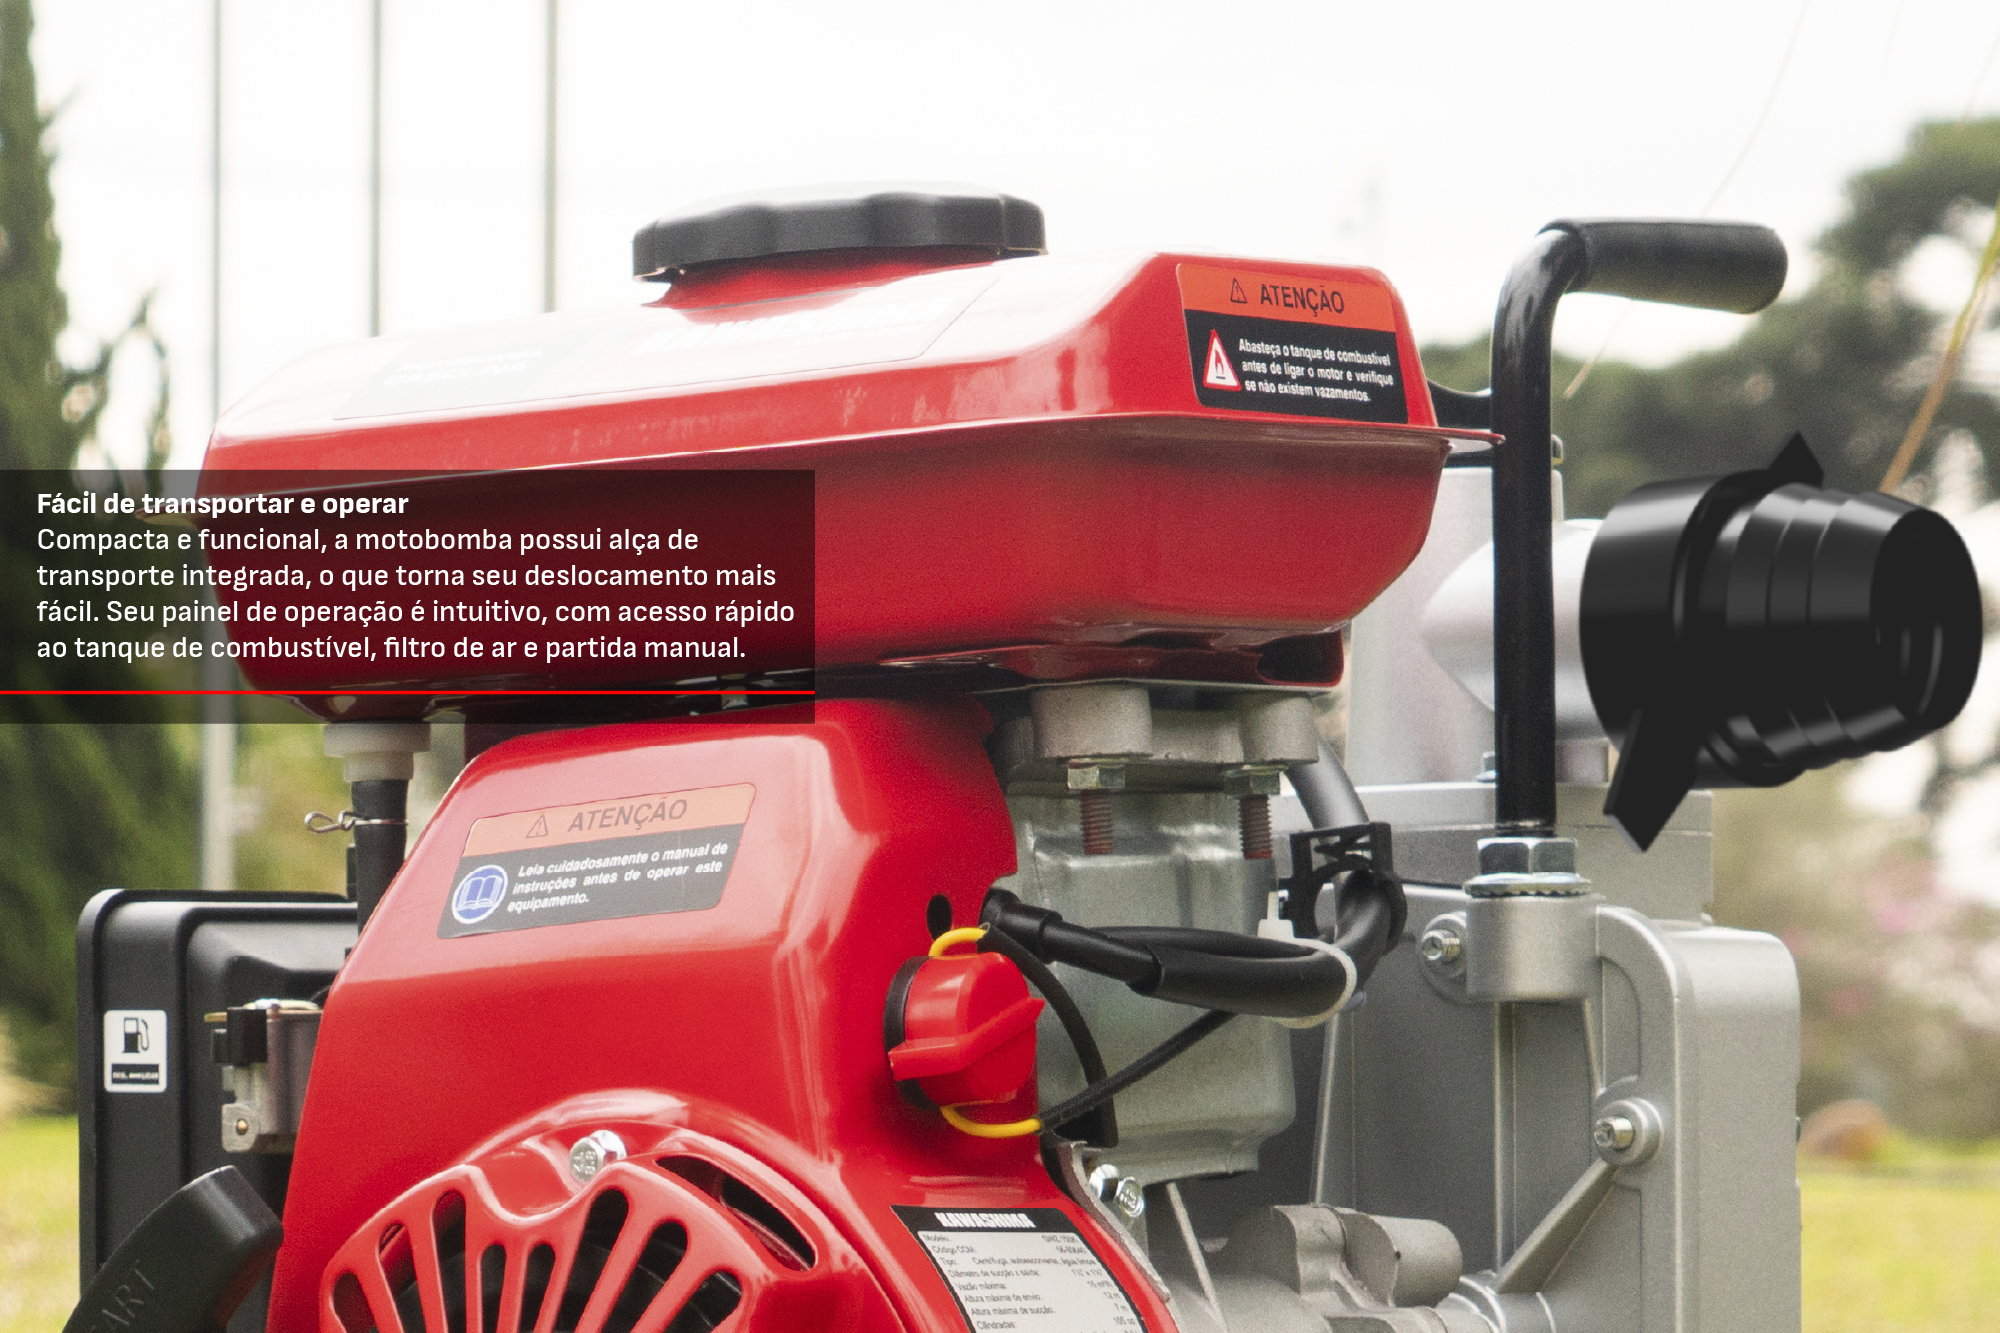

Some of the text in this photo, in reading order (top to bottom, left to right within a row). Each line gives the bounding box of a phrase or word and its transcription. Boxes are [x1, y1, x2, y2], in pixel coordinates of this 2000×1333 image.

[1260, 283, 1344, 317] ATENÇÃO
[1239, 338, 1391, 366] Abasteça o tanque de combustível
[1242, 360, 1394, 387] antes de ligar o motor e verifique
[1245, 379, 1371, 402] se não existem vazamentos.
[567, 796, 687, 832] ATENÇÃO
[518, 842, 728, 877] Leia cuidadosamente o manual de
[512, 860, 723, 894] instruções antes de operar este
[507, 893, 589, 914] equipamento.
[934, 1212, 1036, 1228] KAWASHIMA
[965, 1294, 984, 1302] Altura
[985, 1294, 1011, 1302] máxima
[1012, 1293, 1022, 1301] de
[971, 1307, 991, 1316] Altura
[992, 1306, 1019, 1315] máxima
[1020, 1306, 1029, 1315] de
